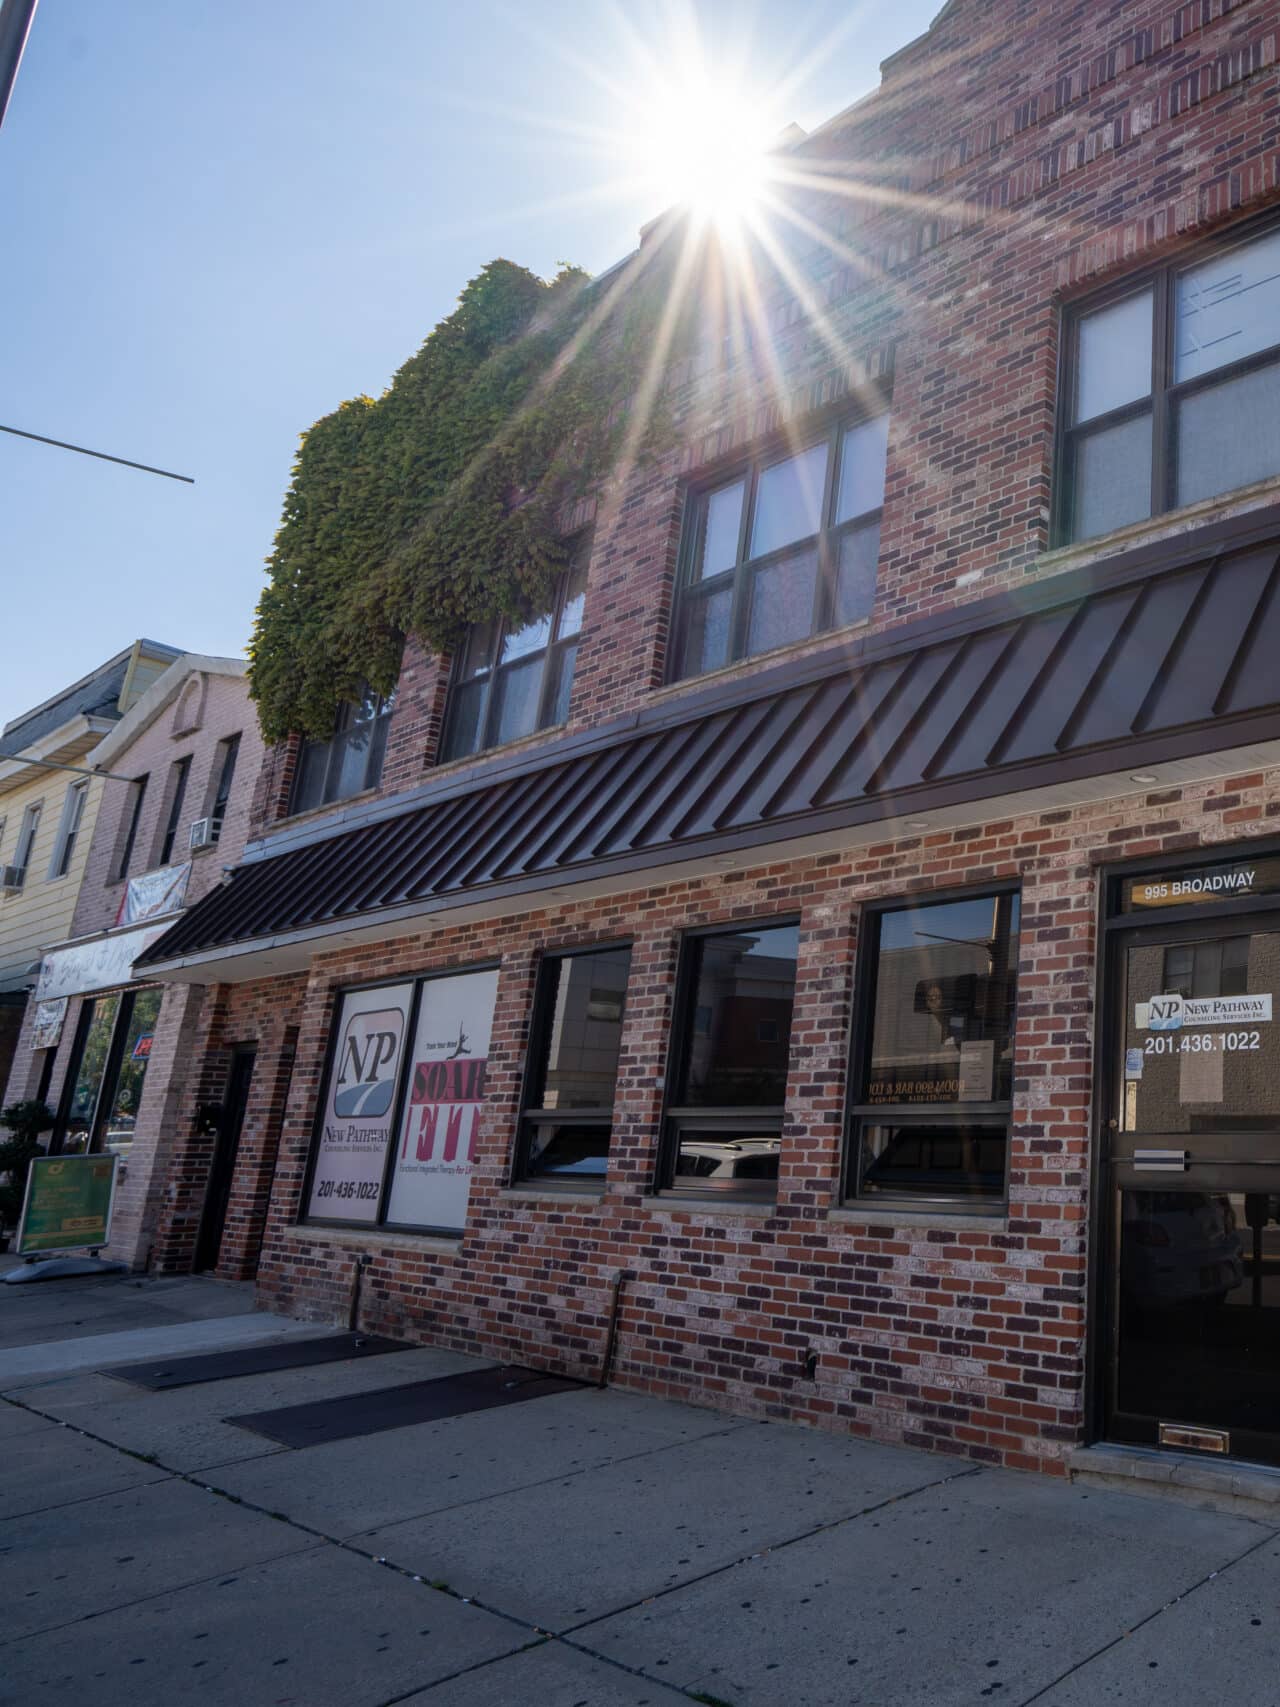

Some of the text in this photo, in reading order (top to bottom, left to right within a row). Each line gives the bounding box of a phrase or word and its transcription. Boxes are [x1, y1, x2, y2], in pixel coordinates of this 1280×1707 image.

[1144, 871, 1256, 900] 995 BROADWAY
[1150, 1001, 1180, 1020] NP
[1144, 1031, 1260, 1055] 201.436.1022
[337, 1031, 397, 1085] NP
